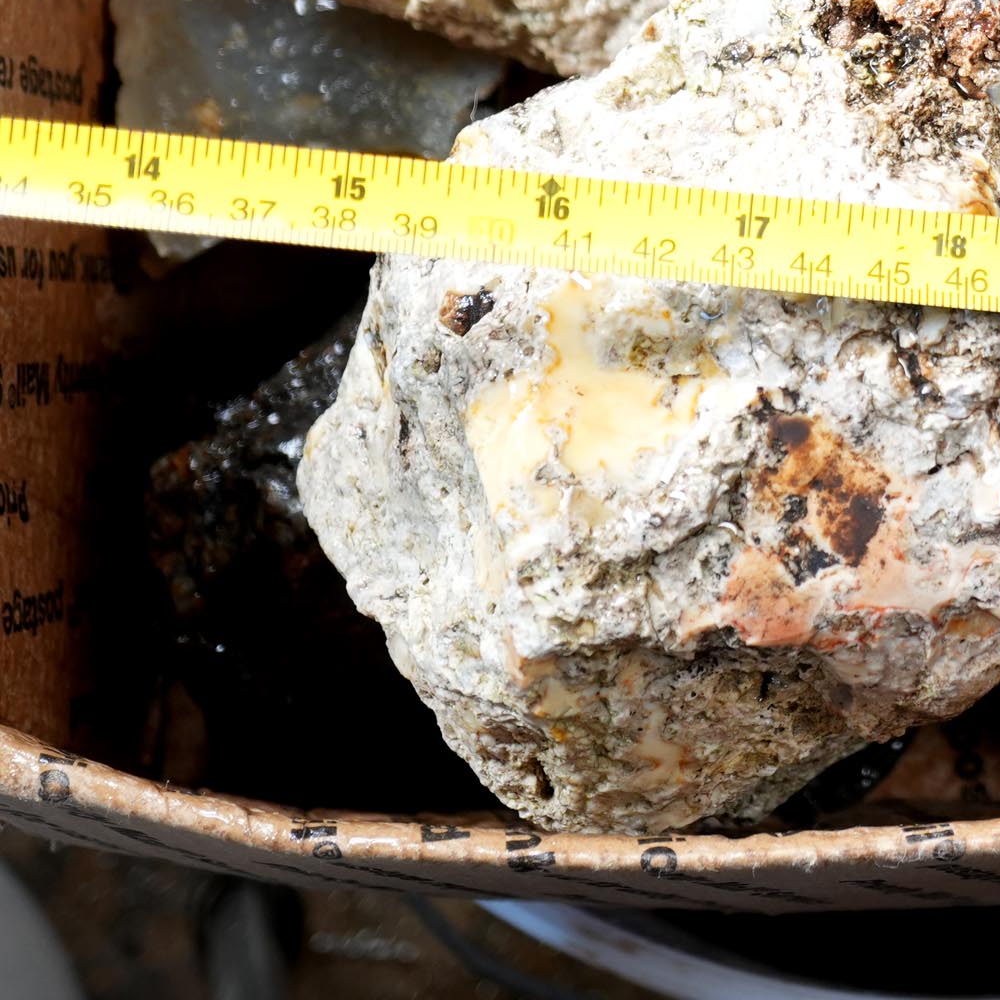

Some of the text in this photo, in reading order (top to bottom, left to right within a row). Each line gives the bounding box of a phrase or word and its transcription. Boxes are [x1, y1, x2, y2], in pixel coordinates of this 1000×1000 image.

[19, 53, 83, 108] postage
[67, 181, 113, 208] 35
[150, 189, 195, 216] 36
[230, 198, 277, 222] 37
[311, 205, 358, 232] 38
[393, 213, 438, 240] 39
[552, 228, 594, 256] 41
[632, 236, 677, 263] 42
[711, 243, 756, 271] 43
[789, 251, 834, 277] 44
[866, 259, 911, 286] 45
[944, 267, 989, 293] 46
[124, 154, 161, 181] 14
[331, 174, 367, 201] 15
[534, 195, 571, 221] 16
[736, 213, 772, 241] 17
[932, 233, 968, 260] 18
[21, 247, 45, 292] for
[1, 579, 65, 639] postage
